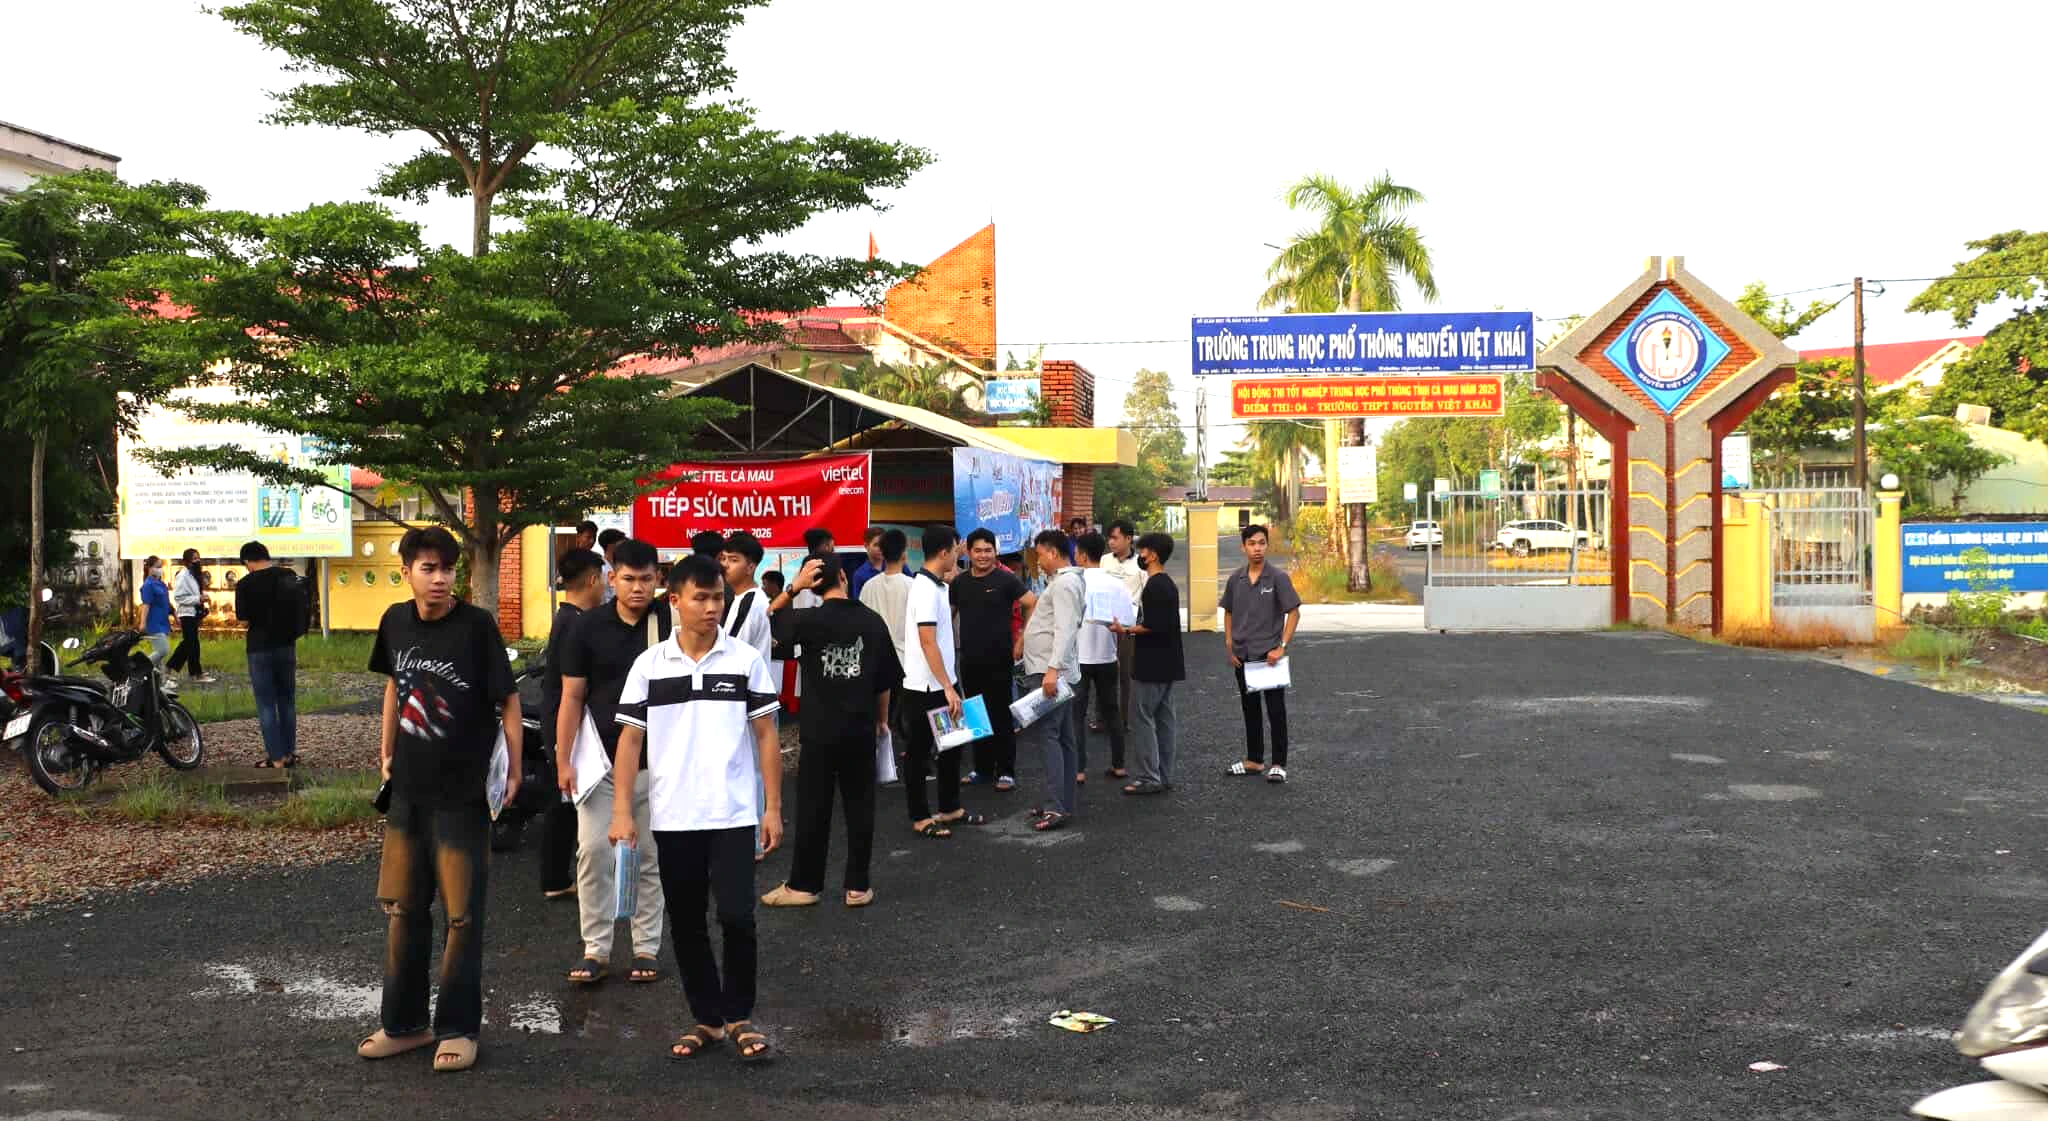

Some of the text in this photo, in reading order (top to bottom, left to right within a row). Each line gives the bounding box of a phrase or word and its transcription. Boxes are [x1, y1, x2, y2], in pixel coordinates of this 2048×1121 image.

[1197, 323, 1526, 364] TRƯỜNG TRUNG HỌC PHỔ THÔNG NGUYỄN VIỆT KHÁI
[1273, 387, 1285, 398] THI
[1287, 384, 1299, 398] TỐT
[1330, 386, 1354, 397] TRUNG
[1354, 386, 1369, 398] HỌC
[1388, 384, 1411, 396] THÔNG
[1431, 383, 1441, 395] CÀ
[1443, 384, 1459, 395] MAU
[1460, 382, 1477, 395] NĂM
[1478, 383, 1497, 395] 2025
[1272, 403, 1293, 412] THI:
[1295, 403, 1307, 412] 04
[1317, 400, 1359, 411] TRƯỜNG
[1362, 400, 1389, 411] THPT
[1438, 398, 1461, 410] VIỆT
[1464, 398, 1492, 409] KHÁI
[747, 470, 774, 482] MAU
[821, 465, 864, 482] viettel
[648, 486, 811, 518] TIẾP SỨC MÙA THI
